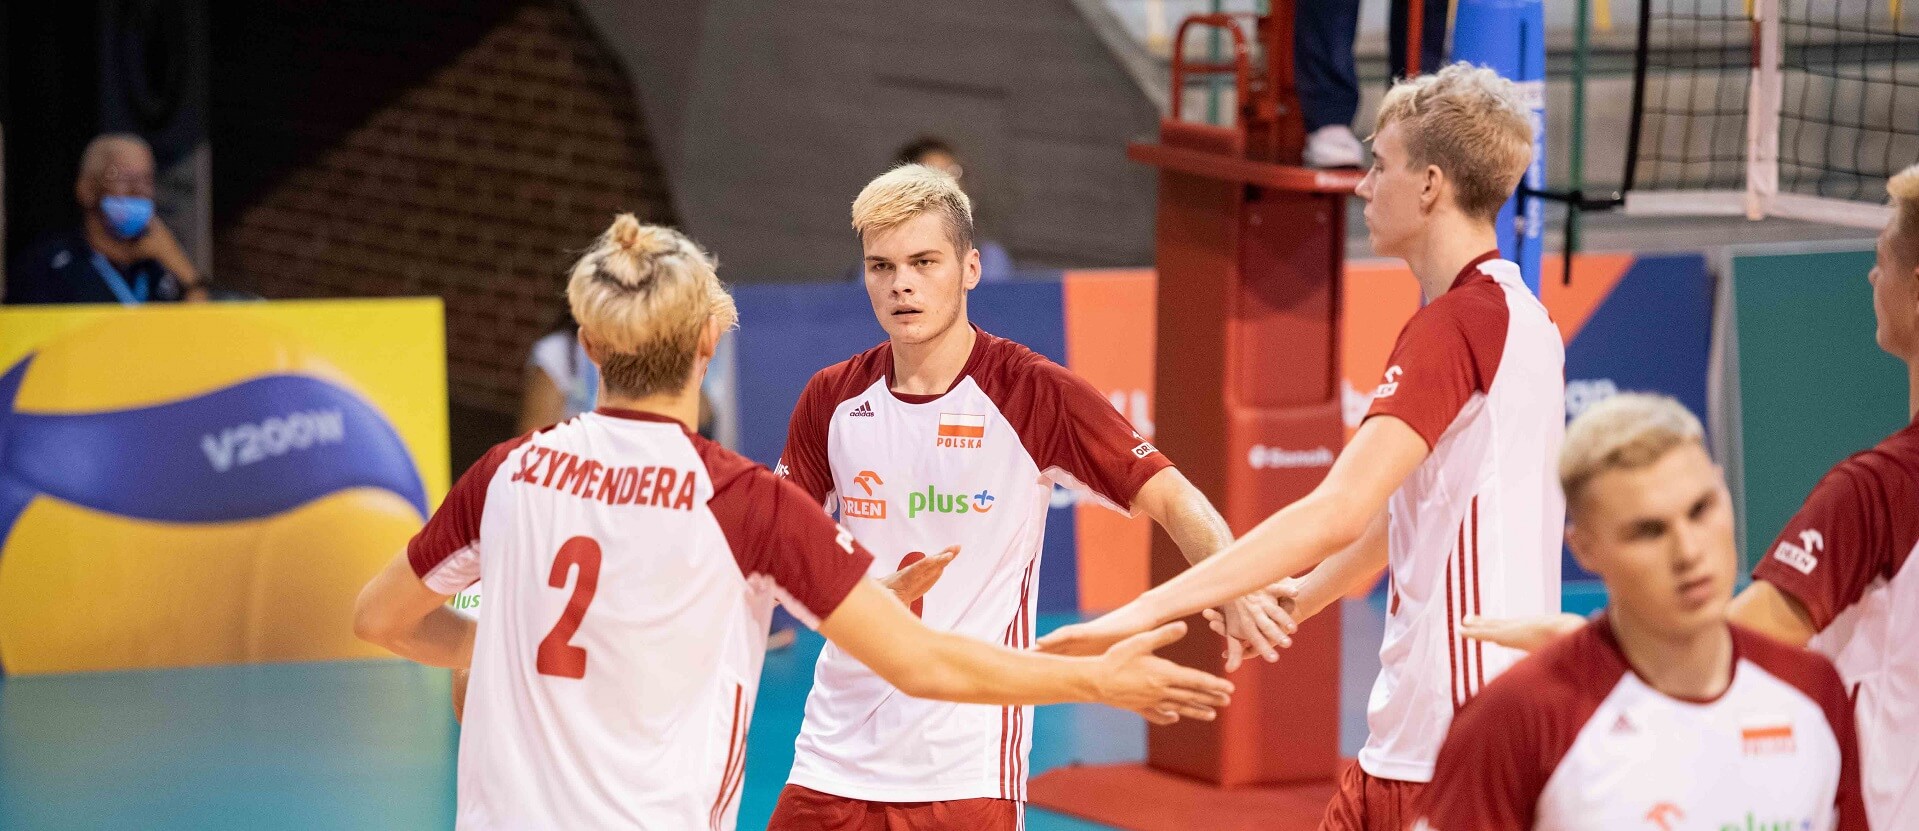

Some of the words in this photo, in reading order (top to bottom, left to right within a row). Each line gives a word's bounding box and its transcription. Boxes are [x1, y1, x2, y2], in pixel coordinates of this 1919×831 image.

[202, 410, 344, 473] V200W
[936, 437, 982, 449] POLSKA
[511, 445, 696, 511] SZYMENDERA
[908, 484, 969, 519] plus
[536, 535, 603, 680] 2
